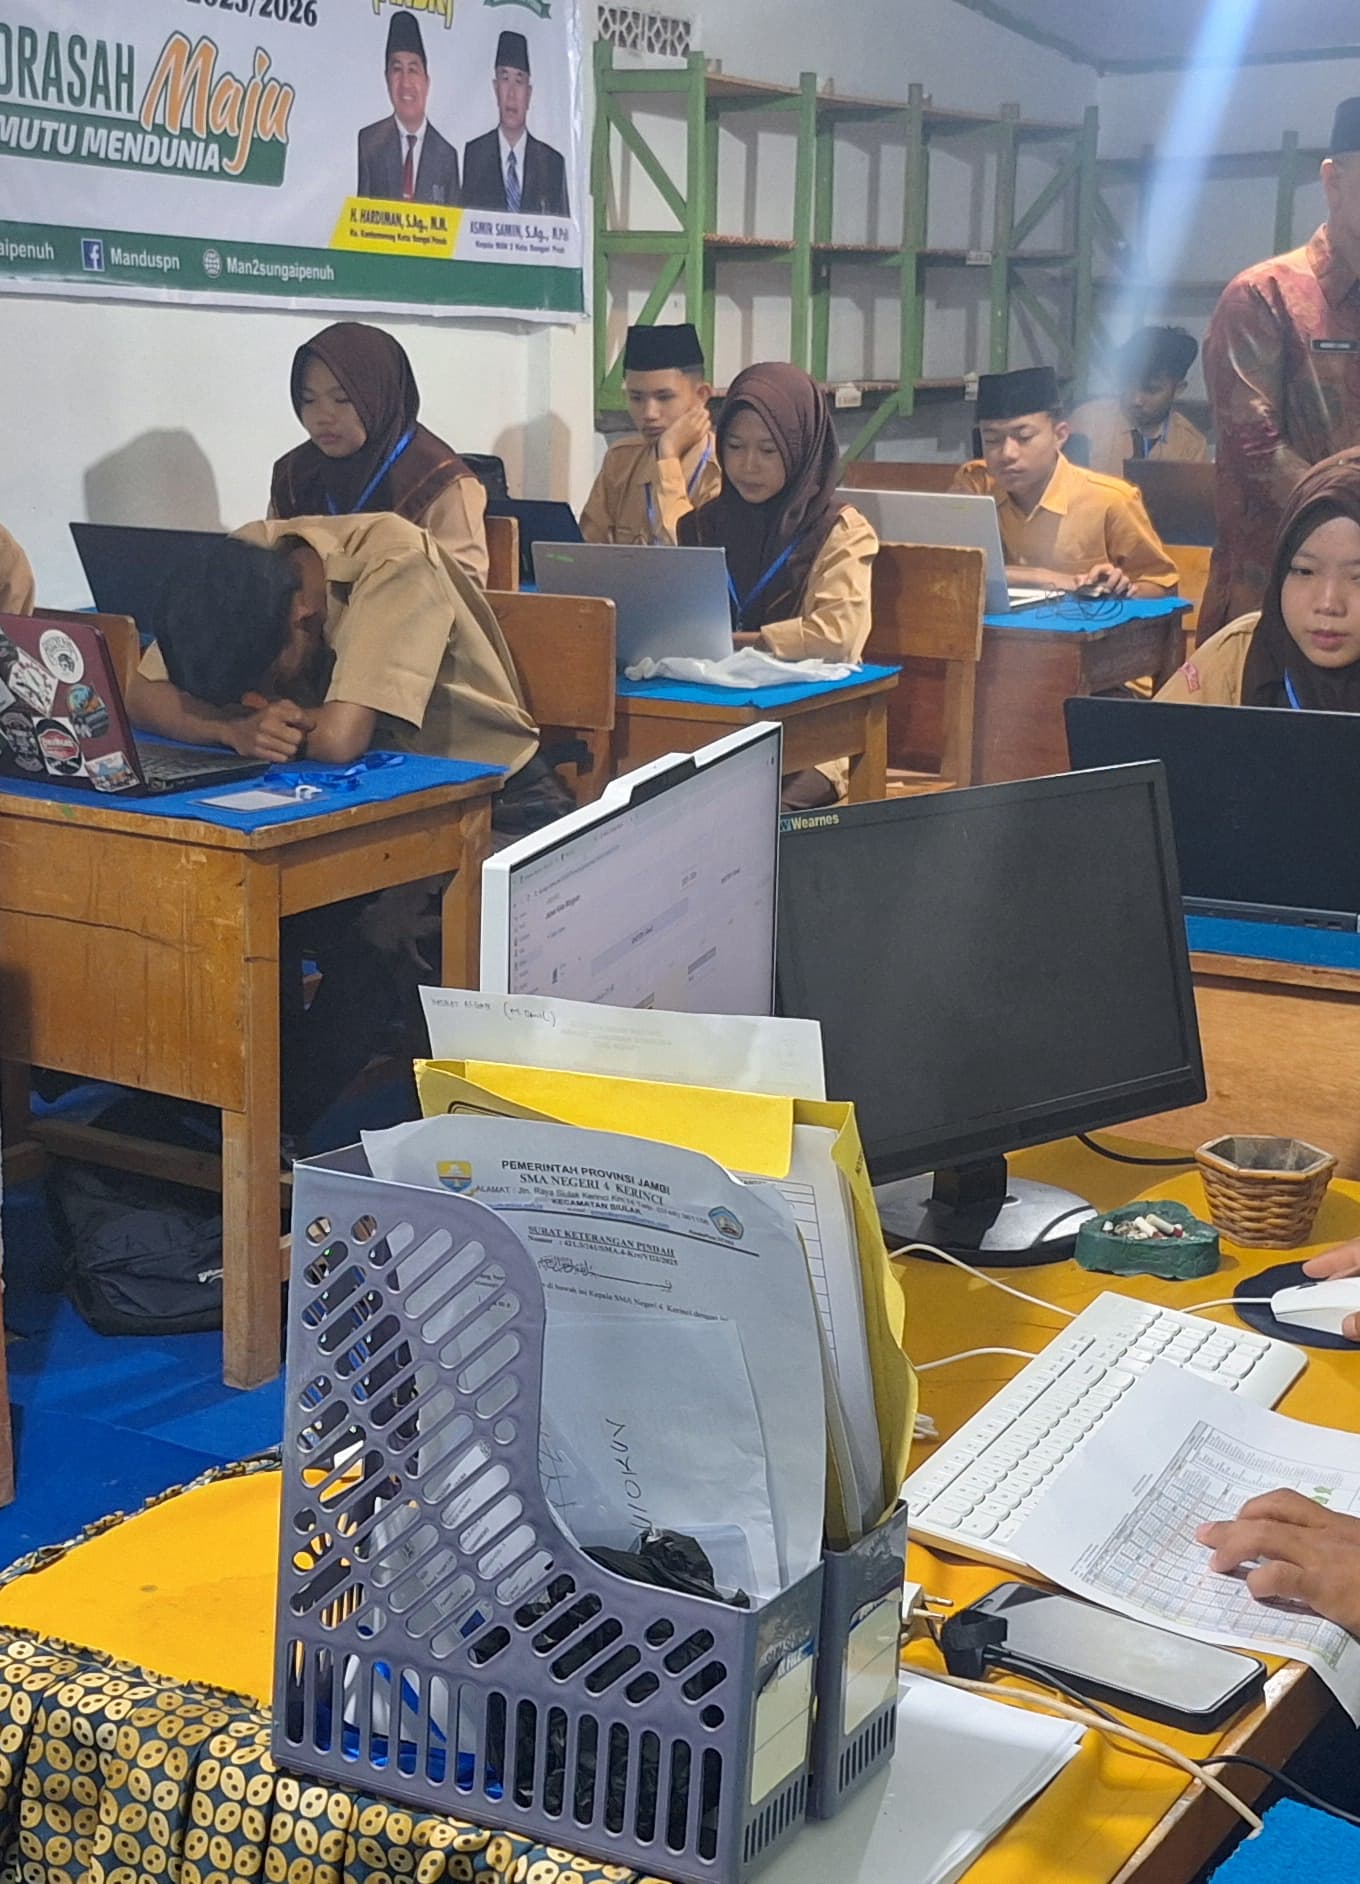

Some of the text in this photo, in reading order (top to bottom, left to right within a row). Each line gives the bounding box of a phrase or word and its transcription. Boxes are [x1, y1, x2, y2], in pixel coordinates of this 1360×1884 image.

[140, 30, 295, 175] Maju
[81, 129, 220, 173] MENDUNIA
[111, 248, 180, 271] Manduspn
[227, 258, 335, 281] Man2sungaipenuh
[791, 814, 840, 830] Wearnes
[502, 1160, 671, 1195] PEMERINTAH PROVINSI JAMBI
[520, 1173, 548, 1185] SMA
[551, 1175, 600, 1190] NEGERI
[616, 1183, 664, 1205] KERINCI
[528, 1225, 676, 1258] SURAT KETERANGAN PINDAH
